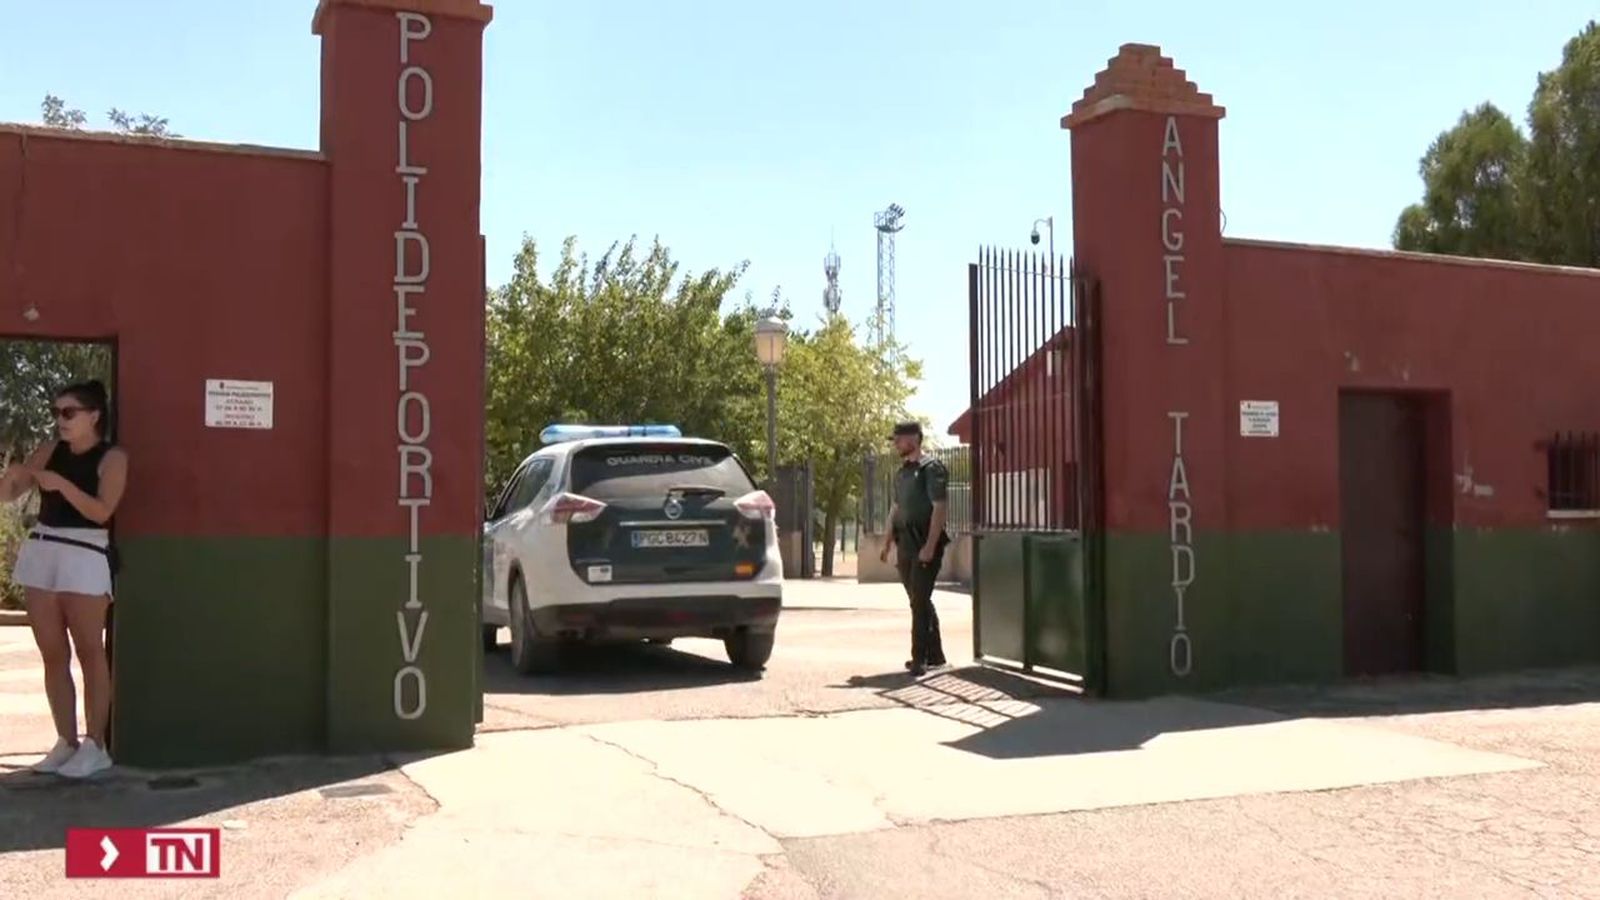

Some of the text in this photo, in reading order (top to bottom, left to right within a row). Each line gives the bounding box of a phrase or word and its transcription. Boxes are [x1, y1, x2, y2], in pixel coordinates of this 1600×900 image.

[394, 11, 434, 720] POLIDEPORTIVO
[1161, 115, 1196, 677] ANGEL TARDIO
